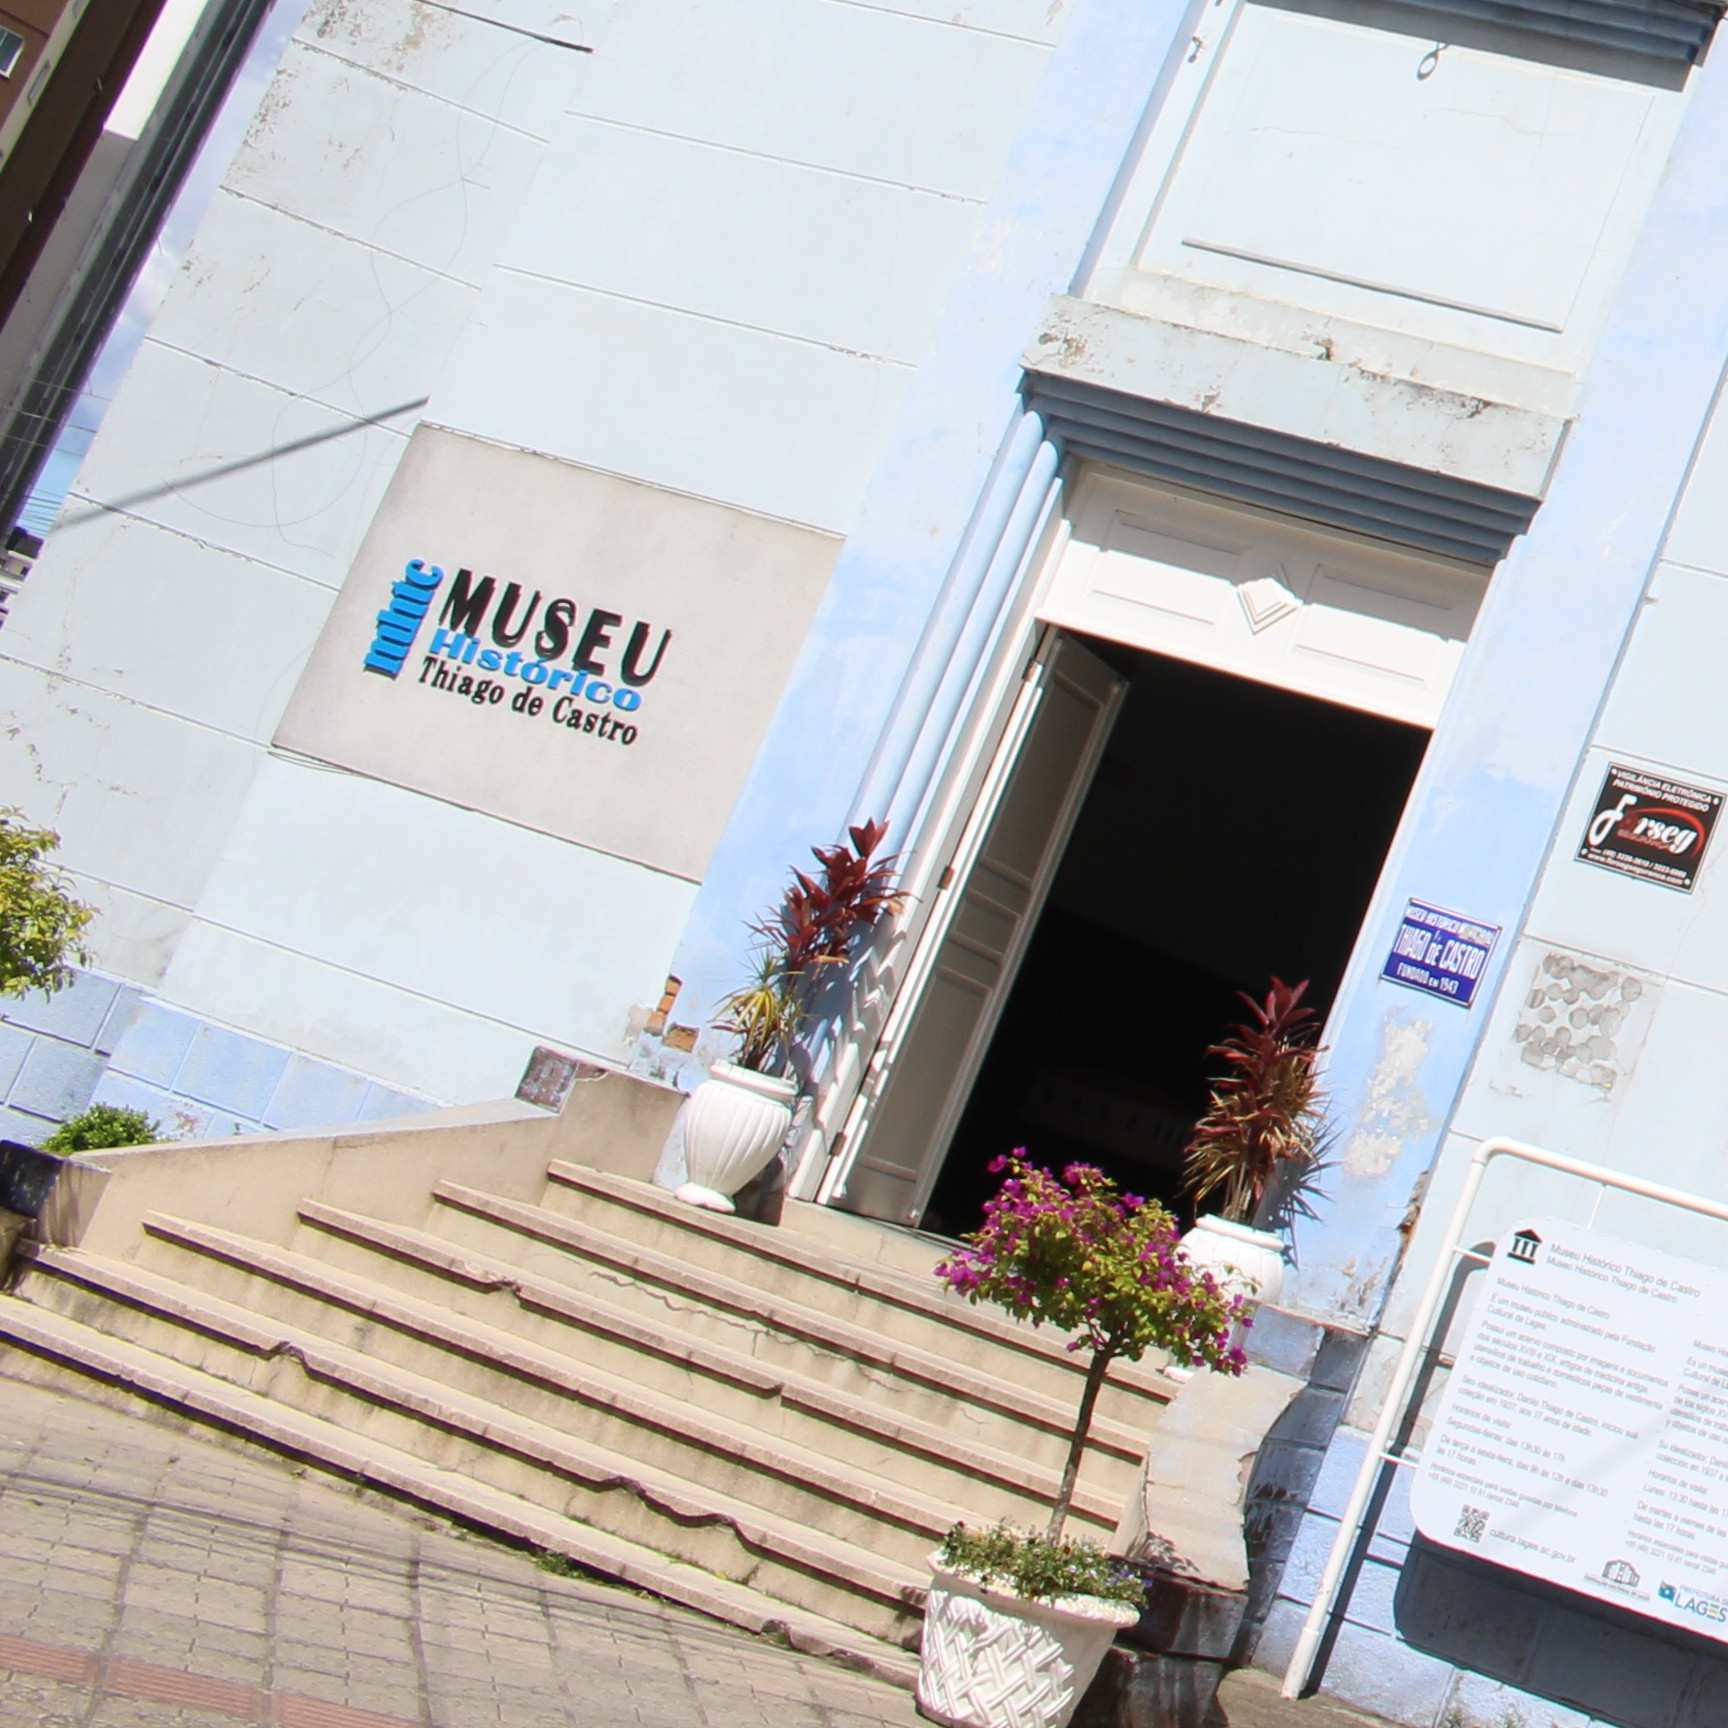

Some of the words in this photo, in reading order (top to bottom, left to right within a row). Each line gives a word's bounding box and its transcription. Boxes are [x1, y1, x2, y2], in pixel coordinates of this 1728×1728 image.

[438, 568, 672, 687] MUSEU
[418, 656, 505, 705] Thiago
[512, 686, 544, 718] de
[552, 695, 639, 746] Castro
[429, 627, 643, 712] Histórico
[1439, 939, 1486, 979] CASTRO
[1549, 1242, 1581, 1260] Museu
[1581, 1252, 1622, 1273] Histórico
[1622, 1266, 1655, 1285] Thiago
[1655, 1276, 1669, 1288] de
[1669, 1280, 1701, 1298] Castro
[1674, 1592, 1728, 1623] LAGES
